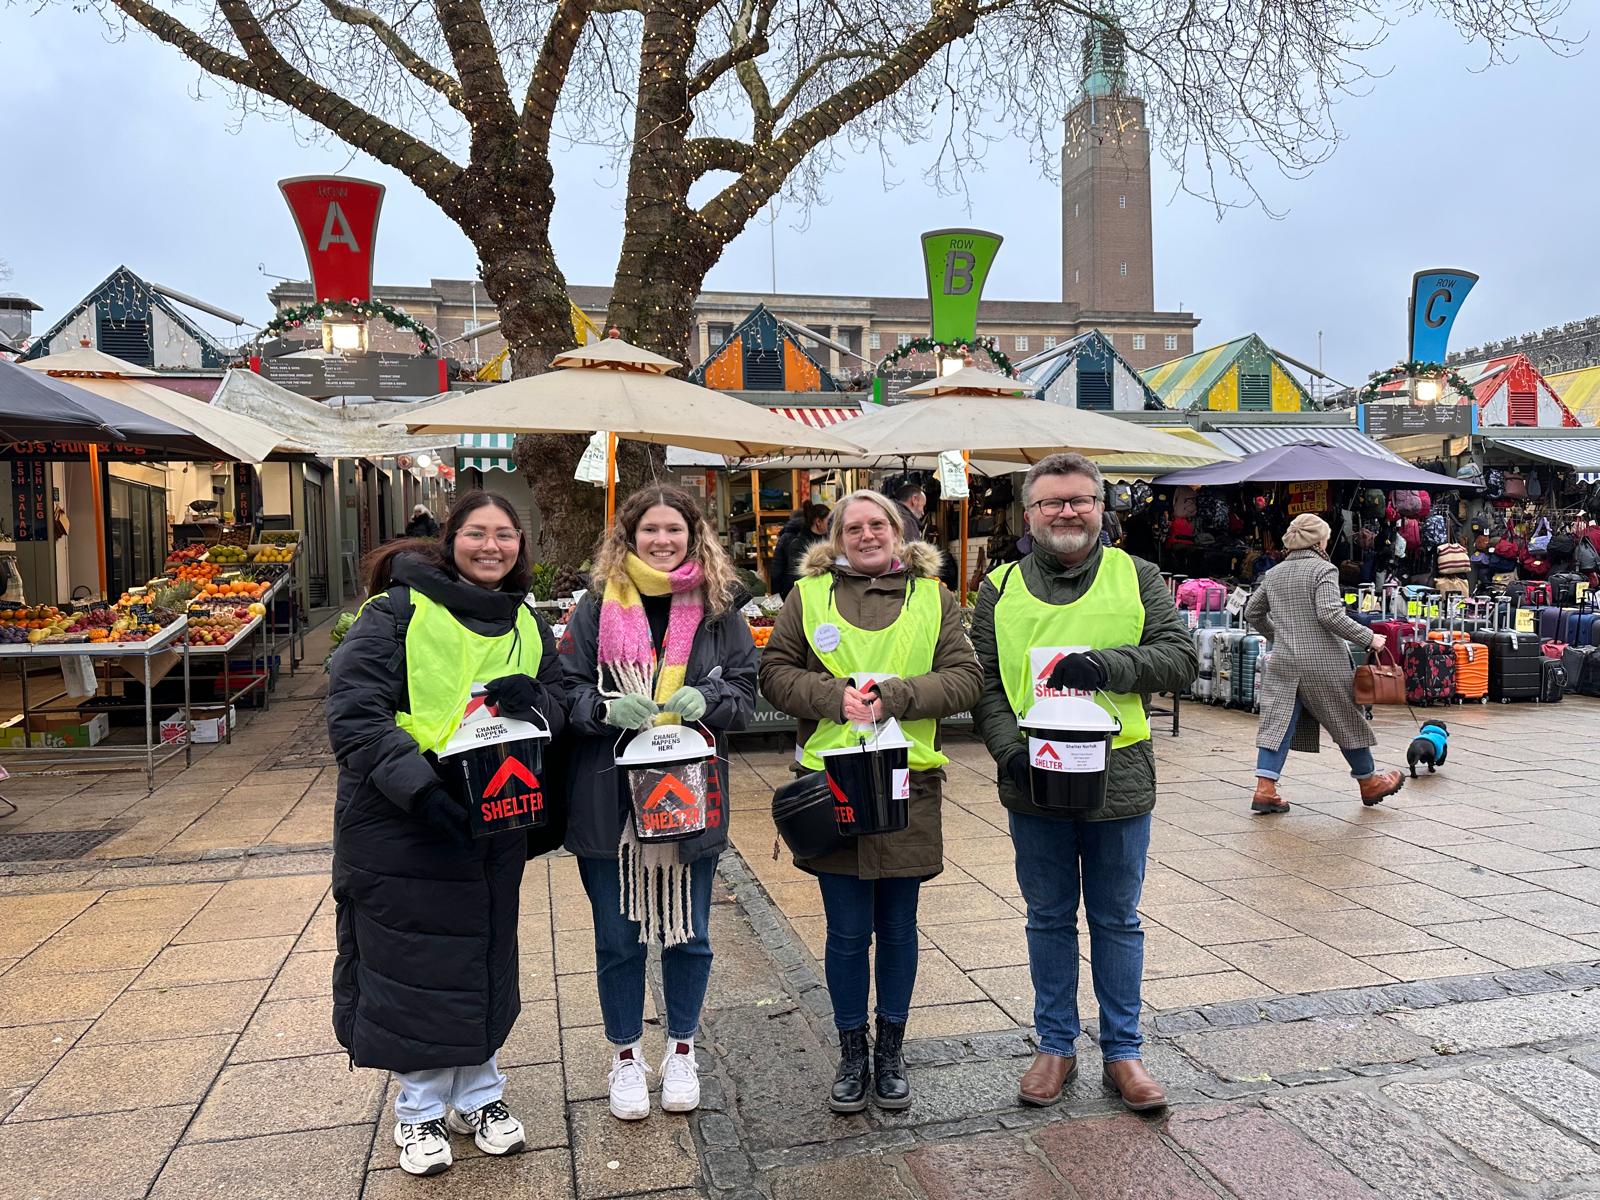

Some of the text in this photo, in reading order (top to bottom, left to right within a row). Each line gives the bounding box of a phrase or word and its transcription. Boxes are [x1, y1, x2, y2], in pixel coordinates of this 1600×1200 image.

[318, 201, 360, 252] A
[949, 239, 974, 249] ROW
[944, 250, 976, 295] B
[1435, 278, 1457, 287] ROW
[1424, 288, 1452, 328] C
[36, 493, 45, 519] VEG
[18, 494, 27, 538] SALAD
[475, 723, 504, 734] CHANGE
[475, 728, 509, 739] HAPPENS
[653, 732, 678, 741] CHANGE
[651, 738, 681, 747] HAPPENS
[1034, 757, 1063, 770] SHELTER
[481, 791, 544, 822] SHELTER
[642, 807, 700, 830] SHELTER
